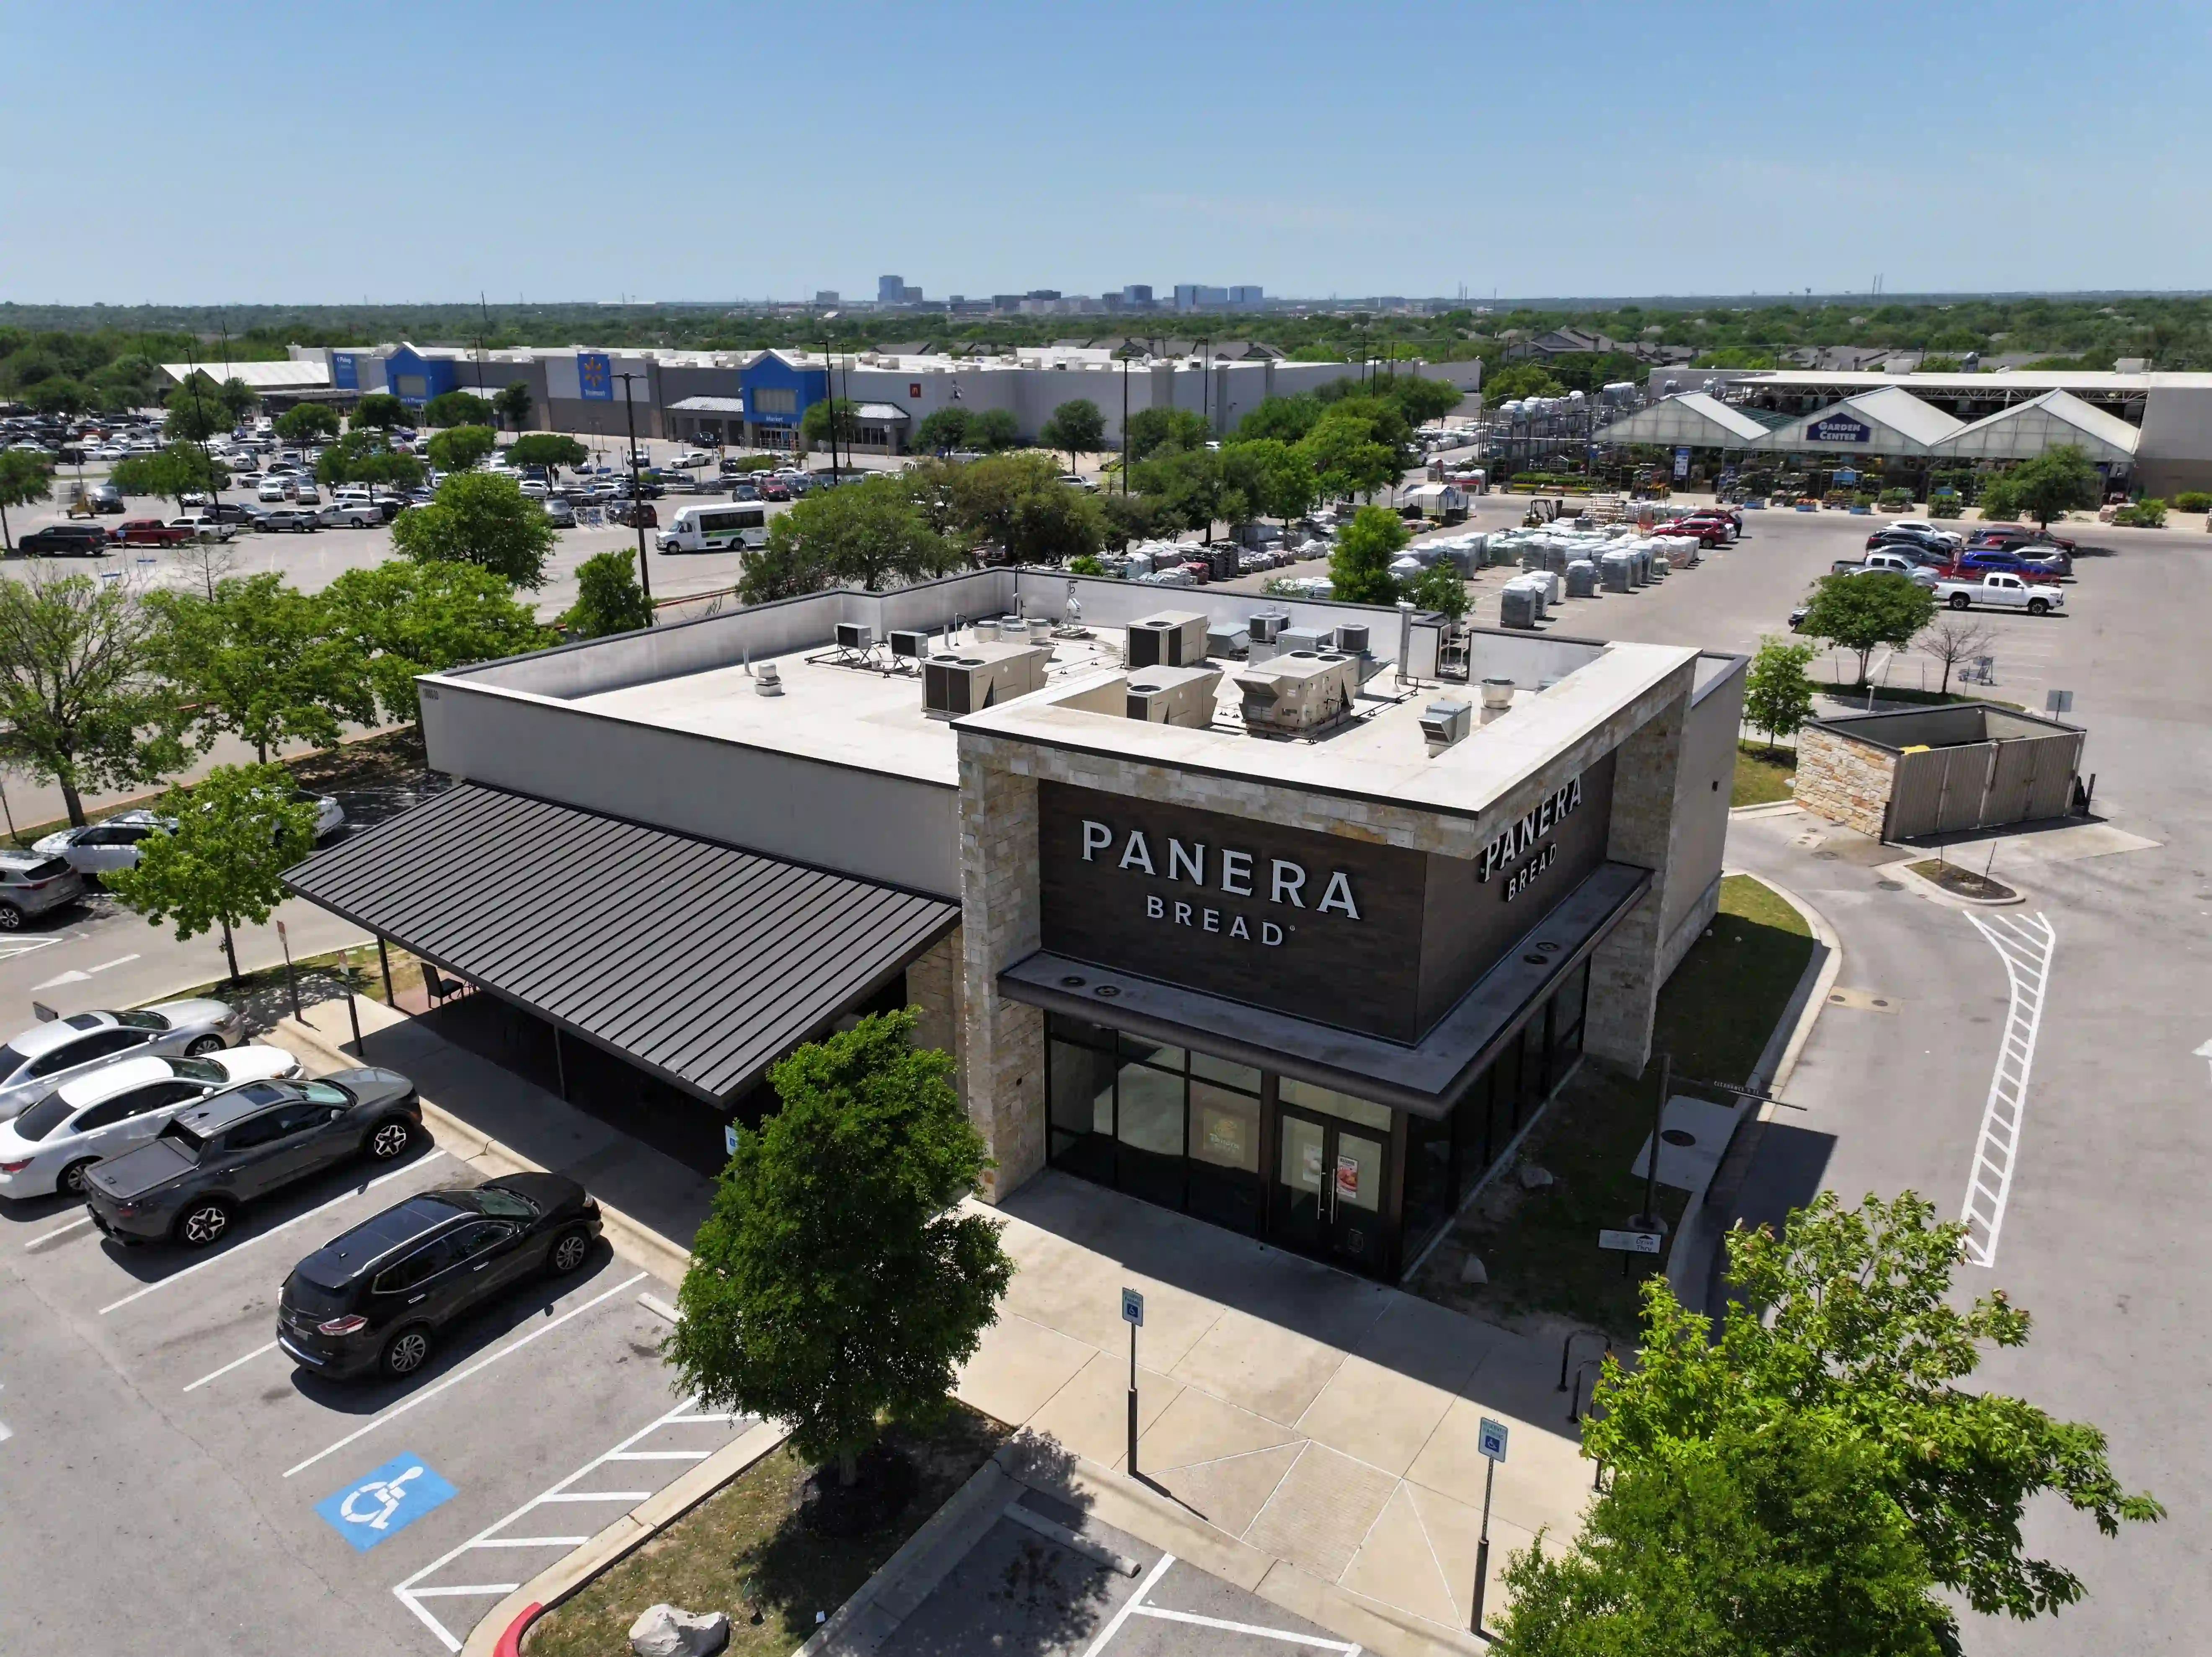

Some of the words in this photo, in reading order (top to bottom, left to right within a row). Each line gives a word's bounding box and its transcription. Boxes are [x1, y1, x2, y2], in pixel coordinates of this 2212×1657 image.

[1818, 421, 1861, 432] GARDEN
[1819, 431, 1856, 440] CENTER
[1485, 773, 1582, 882] PANERA
[1081, 820, 1361, 920] PANERA
[1508, 843, 1557, 902] BREAD
